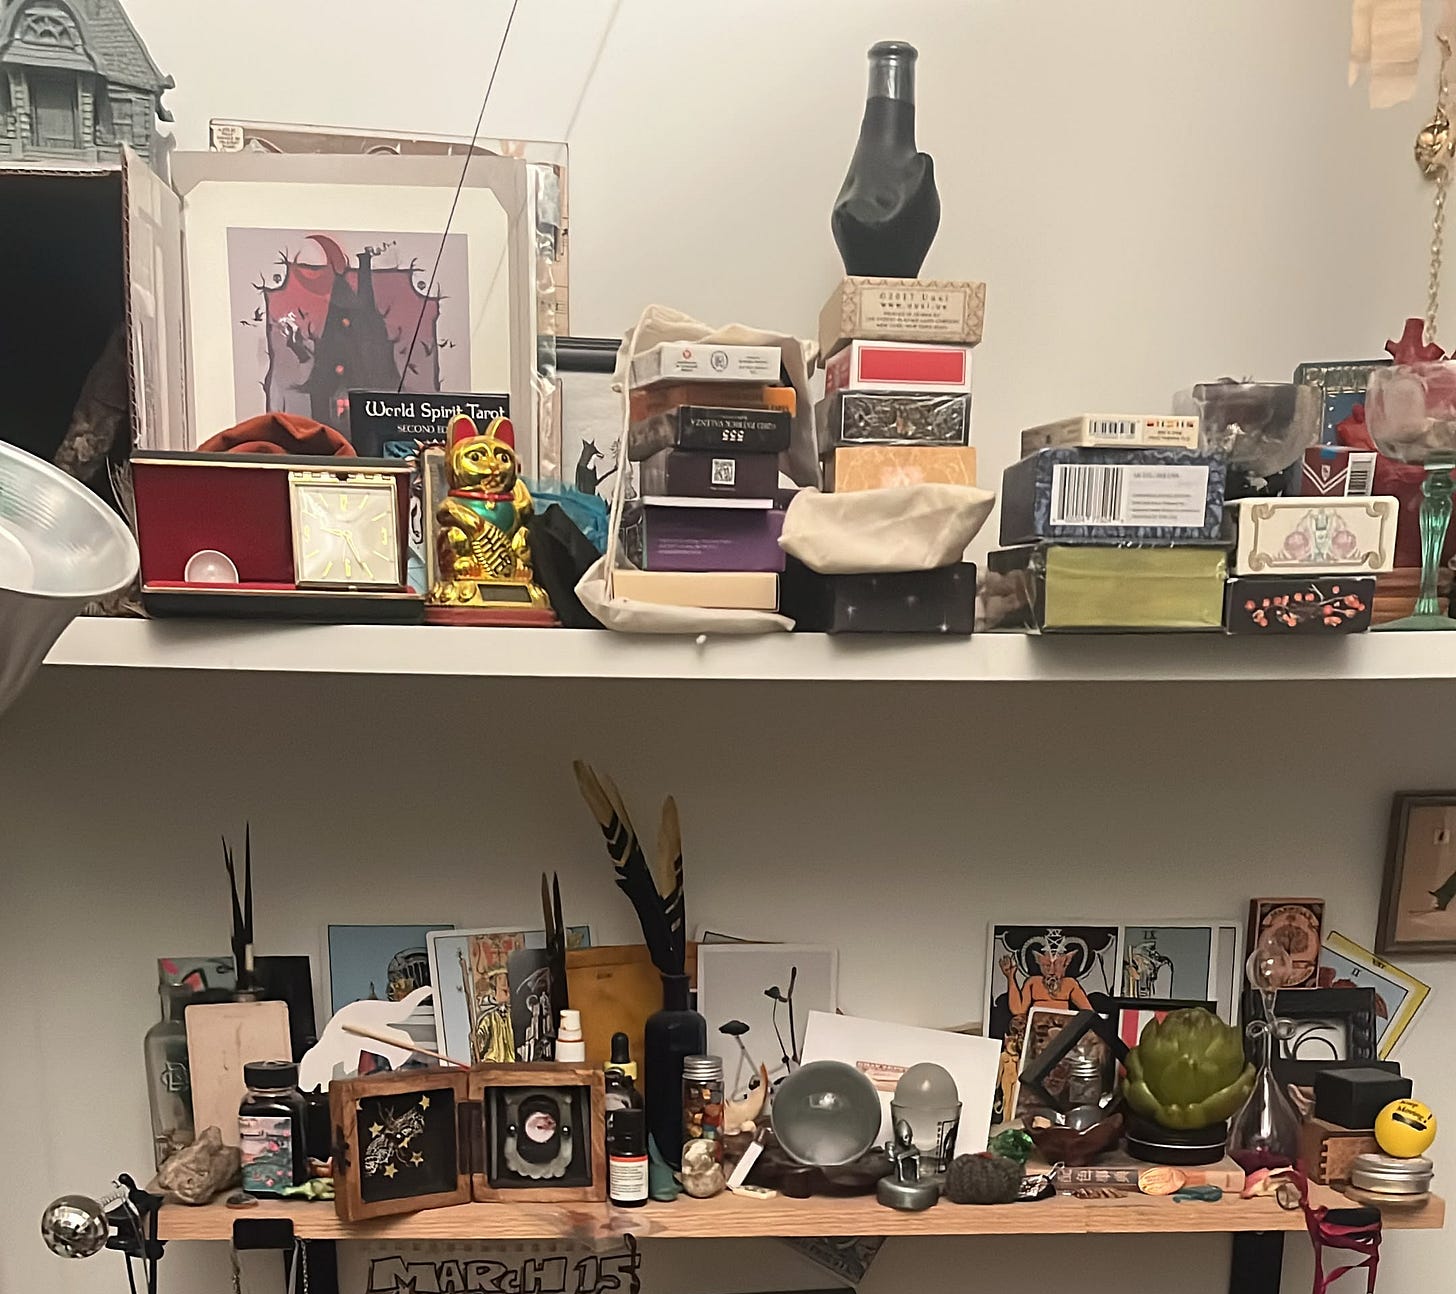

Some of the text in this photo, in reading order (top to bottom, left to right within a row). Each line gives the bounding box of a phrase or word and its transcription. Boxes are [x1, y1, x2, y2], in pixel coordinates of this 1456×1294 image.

[365, 400, 505, 422] World Spirit Tarot
[690, 418, 724, 427] VALENZA
[724, 419, 756, 430] PATRICK
[397, 424, 435, 434] SECOND
[721, 429, 745, 442] 555
[1143, 929, 1158, 940] IX
